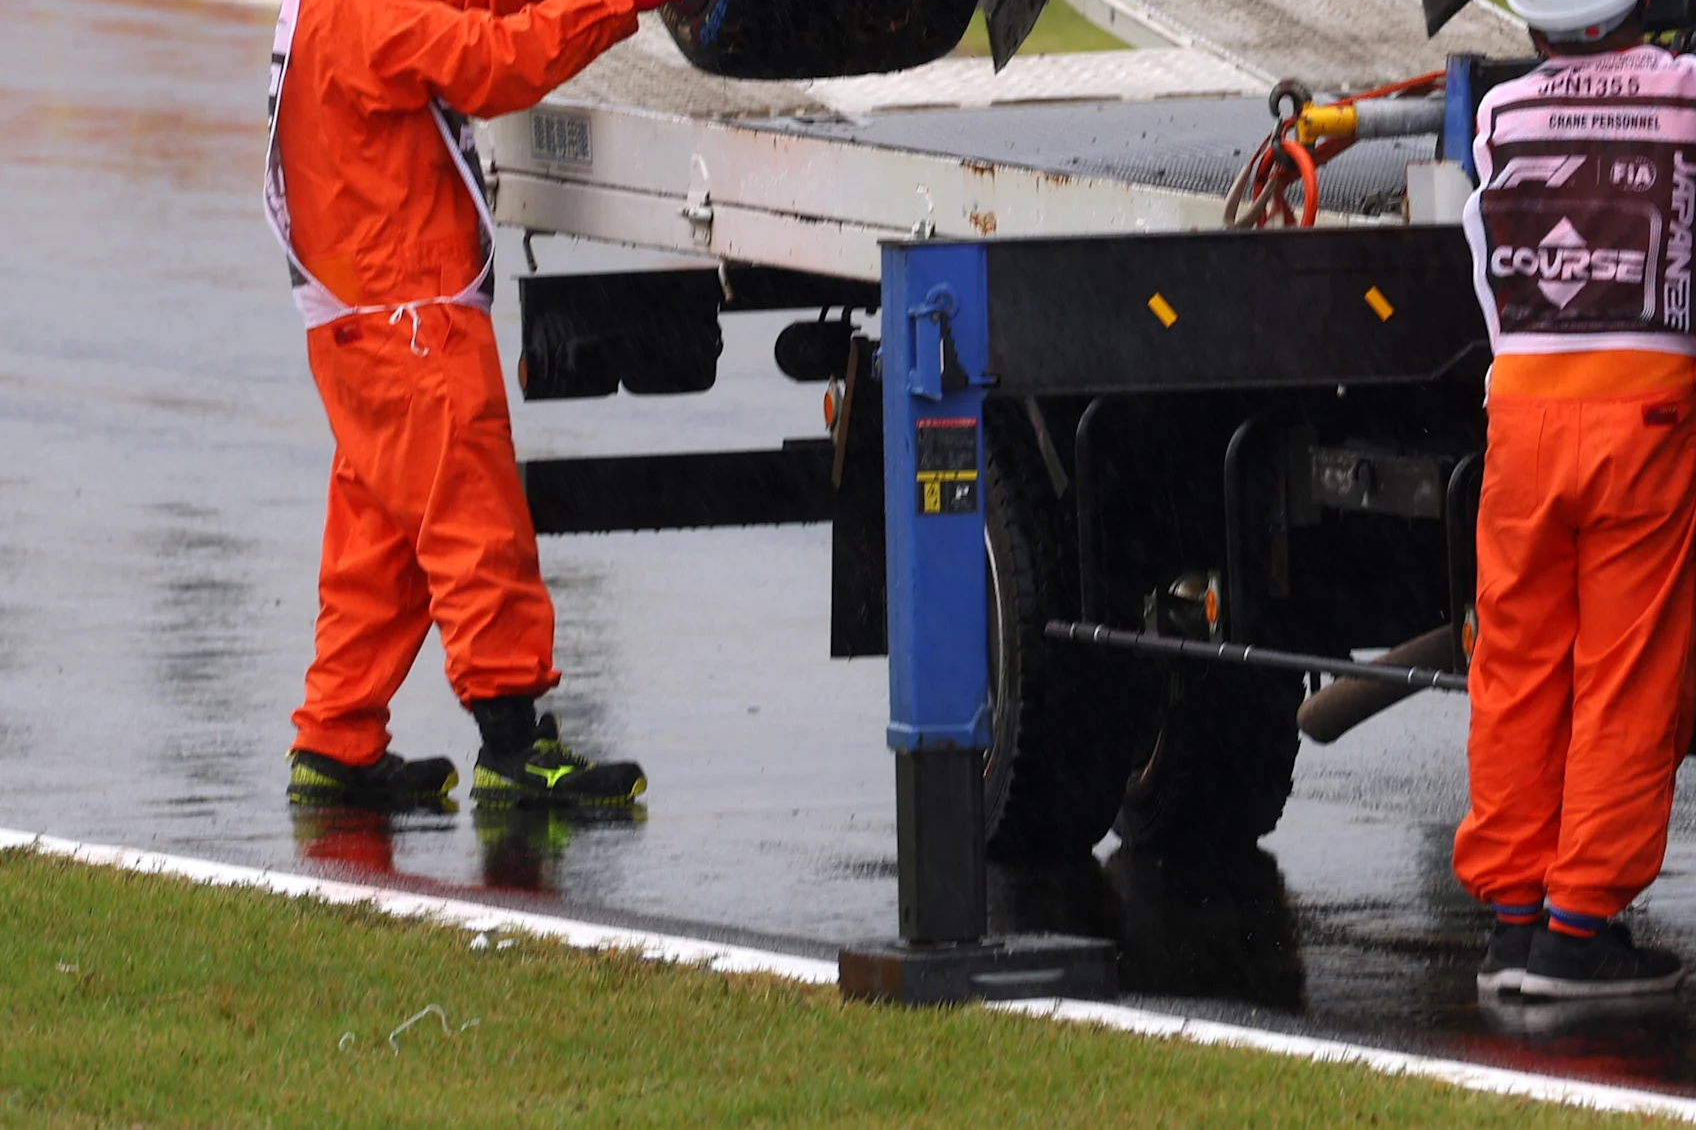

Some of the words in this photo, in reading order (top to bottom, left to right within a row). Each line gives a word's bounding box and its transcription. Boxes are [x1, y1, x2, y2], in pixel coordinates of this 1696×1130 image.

[1548, 112, 1589, 130] CRANE
[1591, 111, 1661, 131] PERSONNEL
[1611, 161, 1652, 187] FIA
[1491, 244, 1647, 283] COURSE
